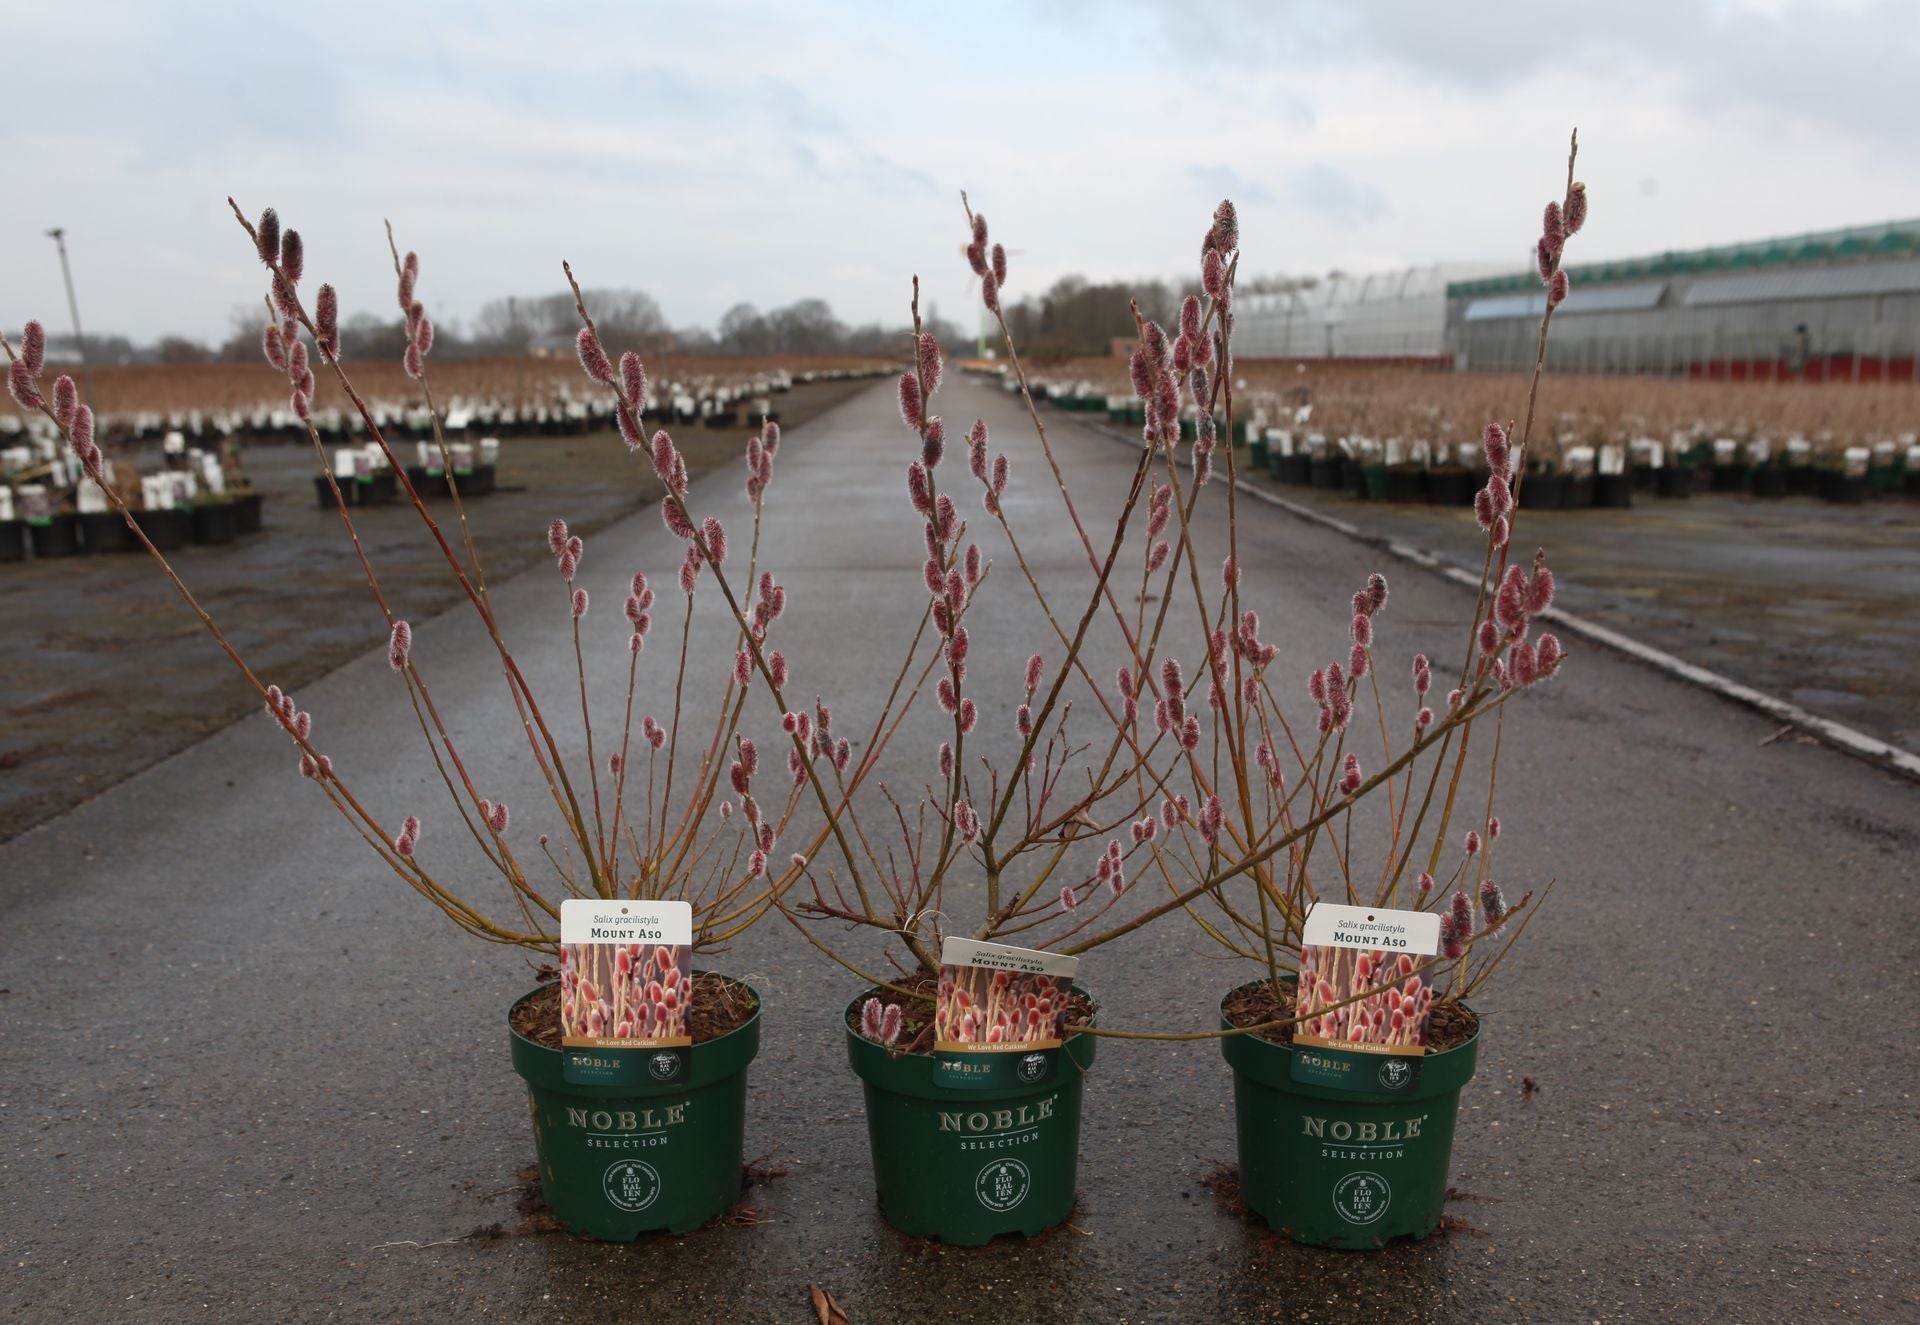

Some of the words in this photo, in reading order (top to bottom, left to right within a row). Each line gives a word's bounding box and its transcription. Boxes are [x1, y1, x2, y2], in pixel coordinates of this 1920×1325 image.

[594, 914, 613, 924] Salix
[614, 915, 659, 926] gracilistyla
[1338, 920, 1358, 929] Salix
[1359, 922, 1406, 934] gracilistyla
[591, 928, 634, 939] MOUNT
[638, 928, 662, 939] ASO
[1334, 932, 1378, 945] MOUNT
[1382, 936, 1407, 948] ASO
[972, 958, 1016, 969] MOUNT
[1020, 964, 1044, 972] ASO
[976, 950, 995, 959] Salix
[997, 952, 1043, 966] gracilistyla
[572, 1057, 620, 1068] NOBLE
[942, 1060, 990, 1072] NOBLE
[1302, 1056, 1350, 1072] NOBLE
[566, 1104, 684, 1130] NOBLE
[937, 1098, 1053, 1132] NOBLE
[1301, 1114, 1422, 1142] NOBLE
[587, 1136, 668, 1148] SELECTION
[960, 1132, 1039, 1150] SELECTION
[1322, 1149, 1404, 1160] SELECTION
